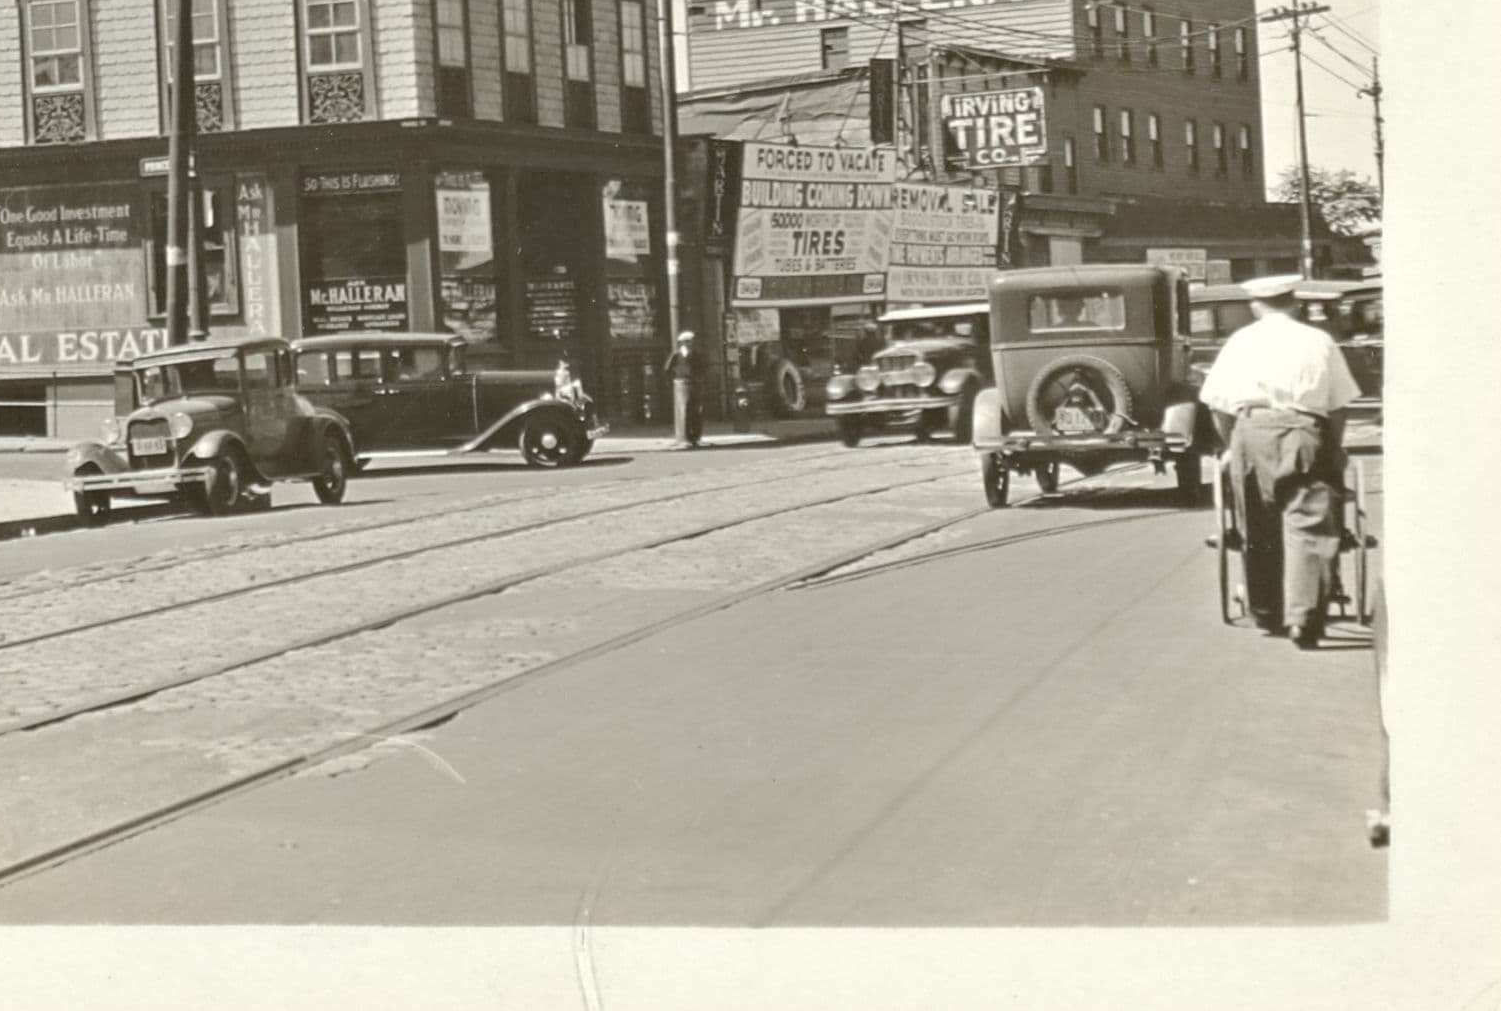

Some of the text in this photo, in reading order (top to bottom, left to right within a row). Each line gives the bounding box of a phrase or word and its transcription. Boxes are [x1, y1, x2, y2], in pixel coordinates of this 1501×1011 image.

[948, 112, 1039, 150] TIRE
[756, 148, 885, 173] FORCED TO VACATE
[239, 183, 263, 200] Ask
[742, 181, 892, 209] BUILDING COMING DOWN
[26, 204, 58, 223] Good
[60, 203, 131, 221] Investment
[6, 226, 128, 250] Equals A Life-Time
[792, 230, 846, 256] TIRES
[244, 221, 265, 334] HALLERA
[0, 289, 27, 307] Ask
[56, 283, 135, 303] HALLERAN
[56, 329, 168, 362] ESTAT
